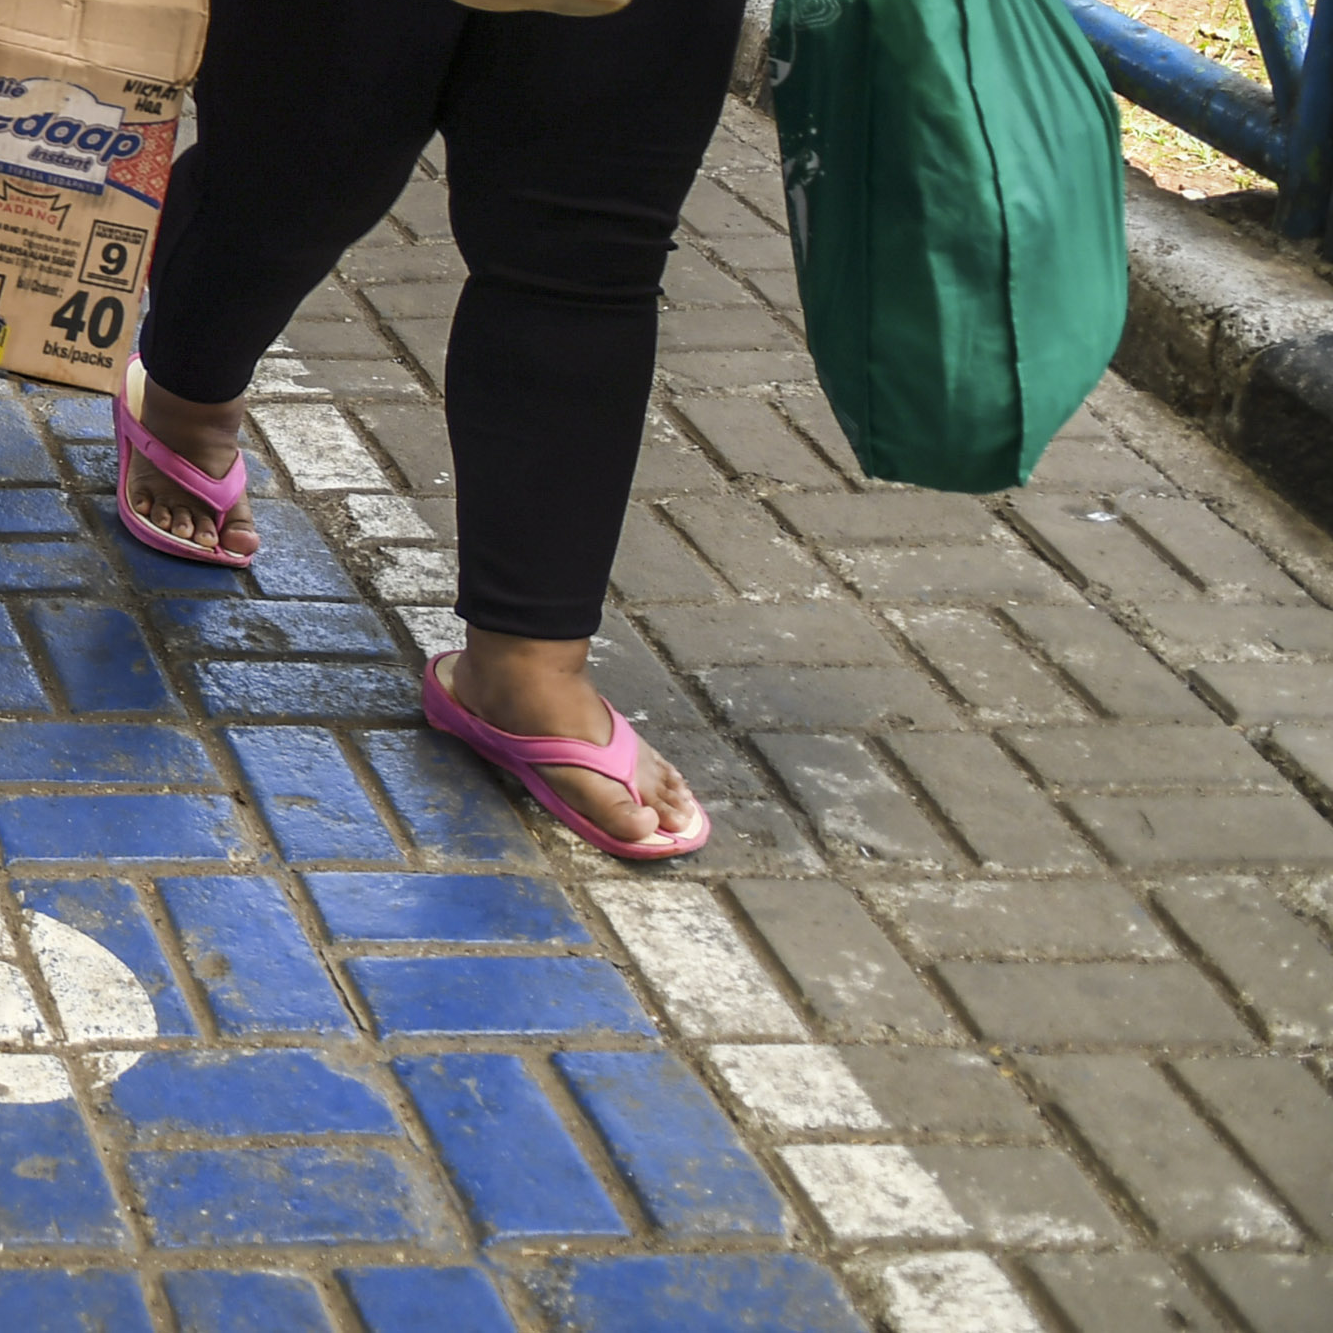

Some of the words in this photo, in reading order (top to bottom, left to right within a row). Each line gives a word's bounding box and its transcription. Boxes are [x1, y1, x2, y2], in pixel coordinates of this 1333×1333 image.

[123, 79, 179, 104] NIKMAT
[98, 242, 128, 276] 9
[51, 290, 125, 349] 40
[42, 340, 114, 369] bks/packs
